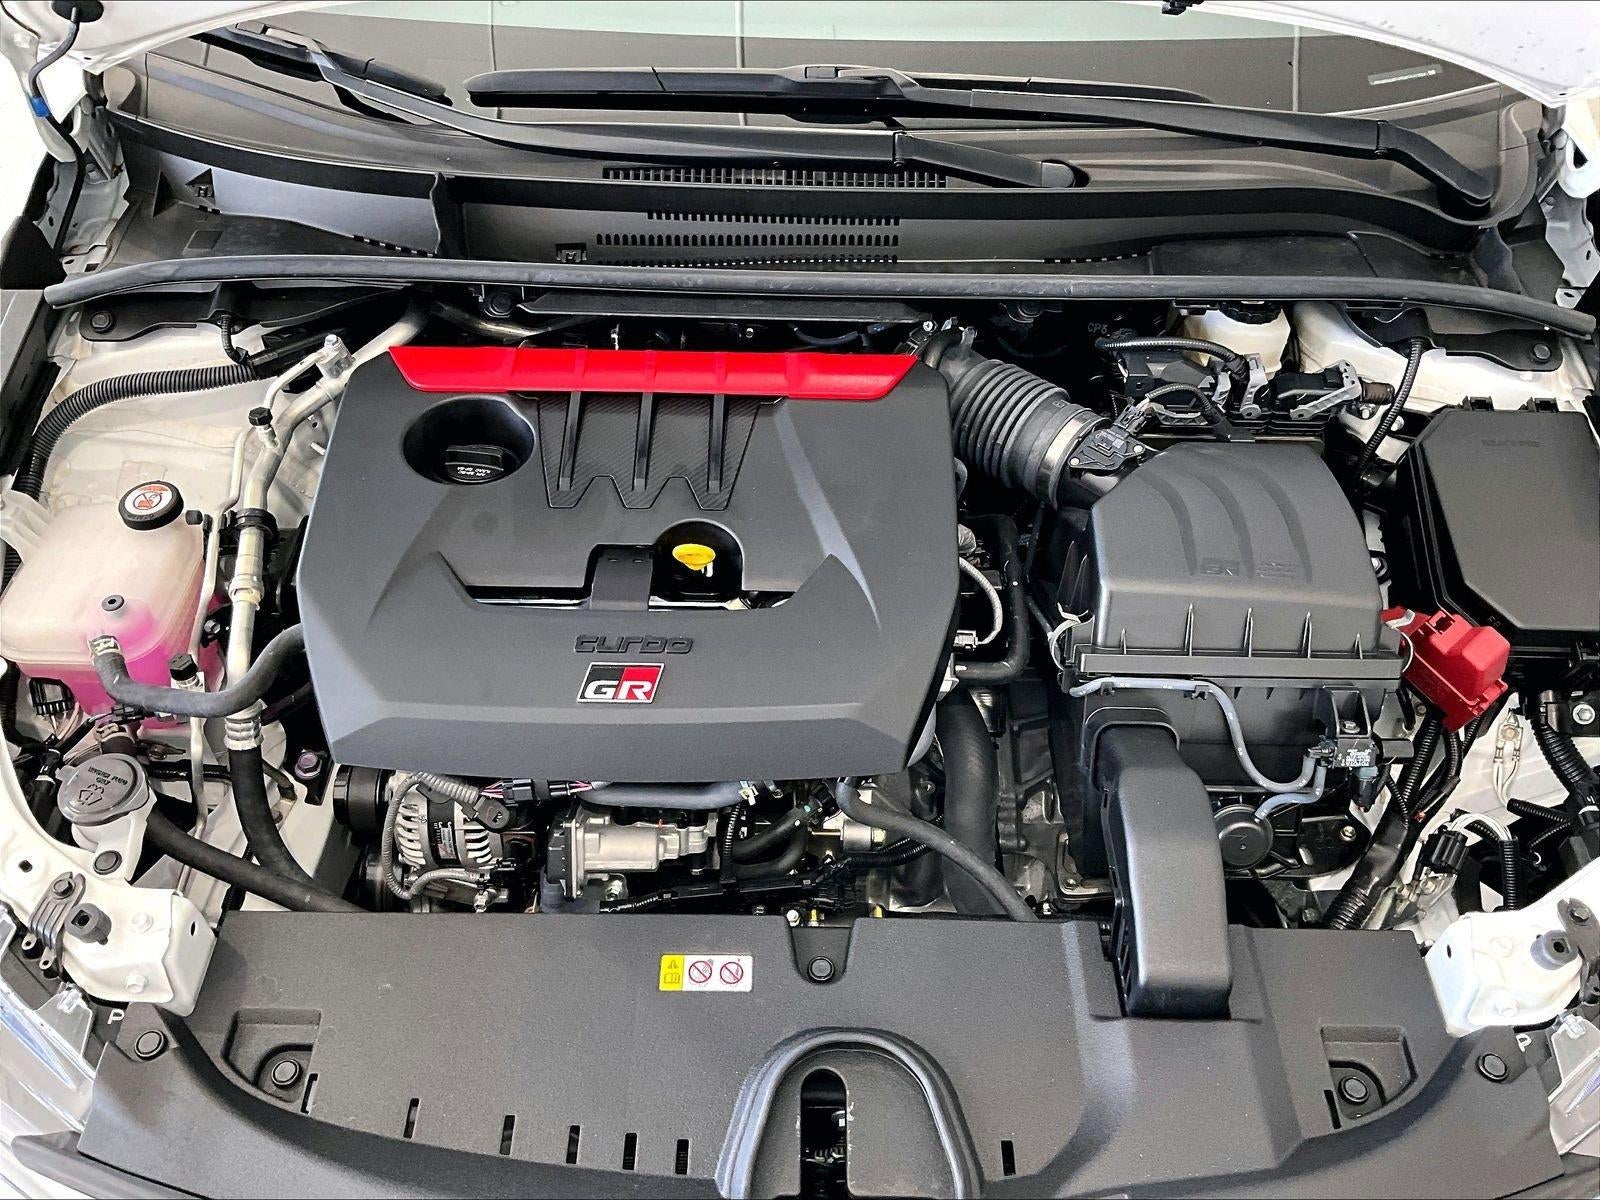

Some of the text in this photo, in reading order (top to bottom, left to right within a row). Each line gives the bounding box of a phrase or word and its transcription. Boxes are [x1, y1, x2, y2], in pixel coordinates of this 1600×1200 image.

[584, 680, 653, 700] GR
[107, 1009, 125, 1025] P
[1515, 1033, 1532, 1052] P
